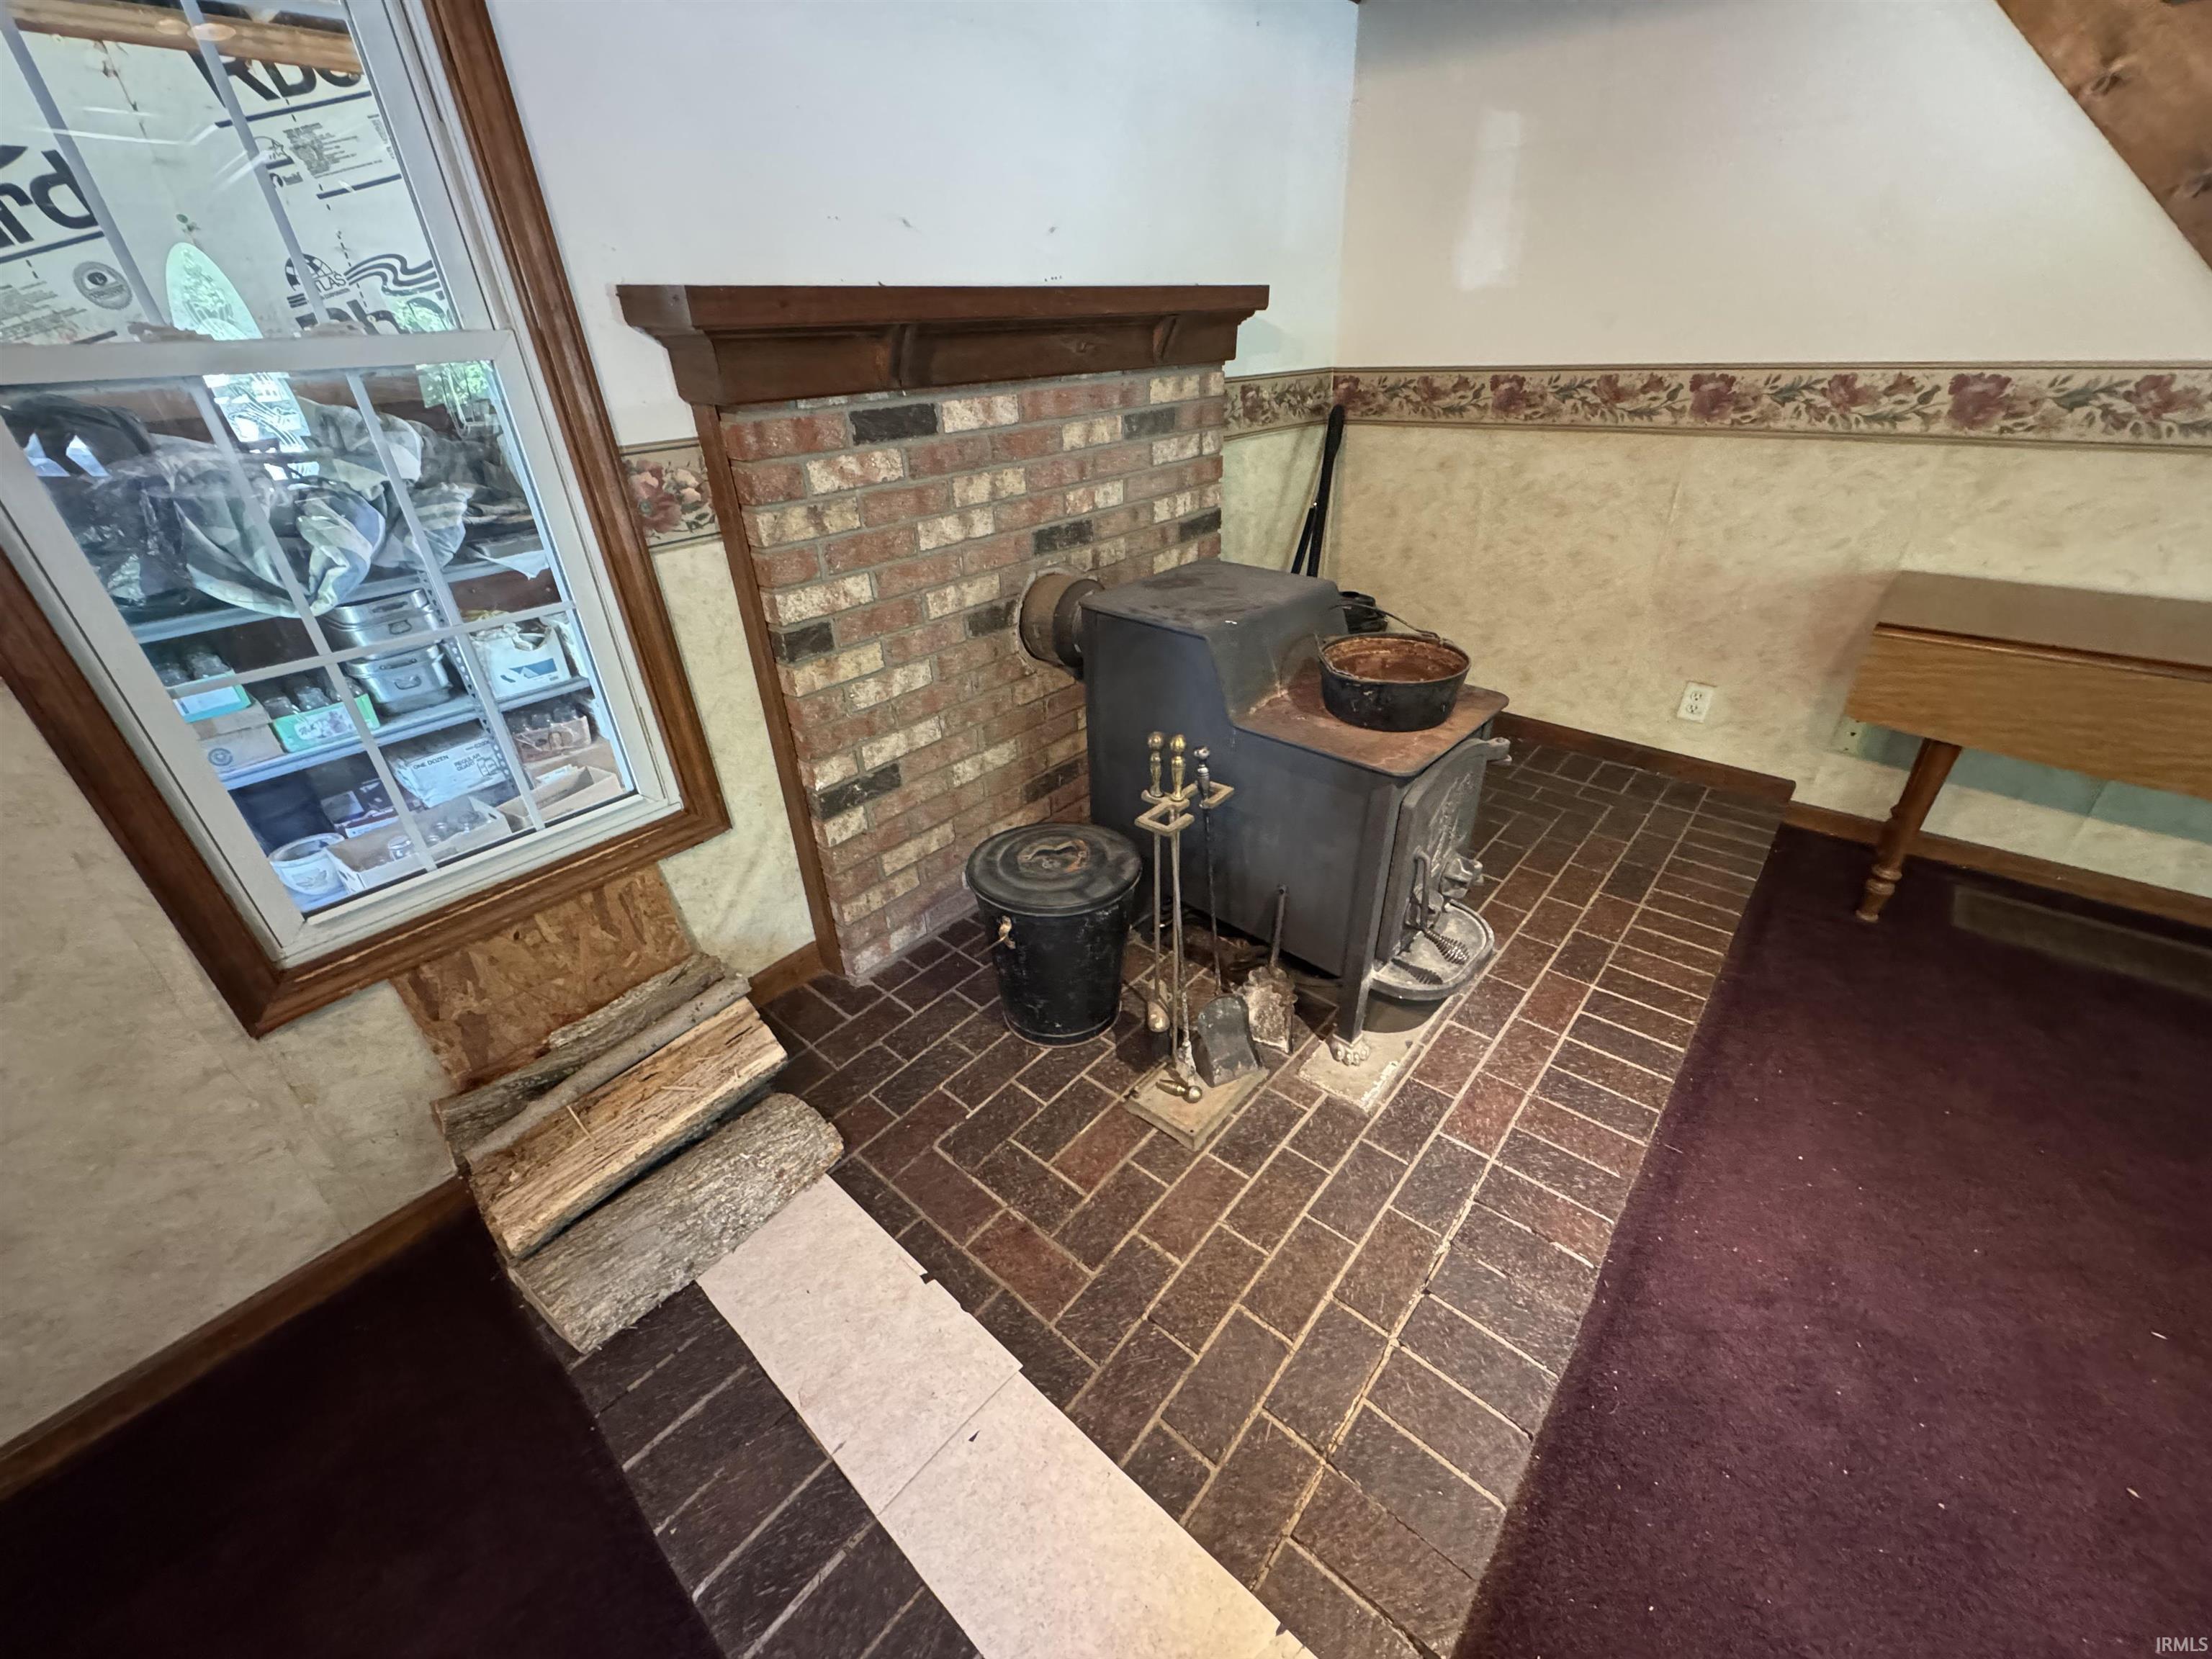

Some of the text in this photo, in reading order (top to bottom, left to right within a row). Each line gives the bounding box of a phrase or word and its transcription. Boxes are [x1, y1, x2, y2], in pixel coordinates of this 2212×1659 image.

[0, 149, 99, 248] rd
[427, 755, 450, 765] DOZEN
[454, 753, 481, 768] REGULAR
[456, 760, 476, 772] QUART
